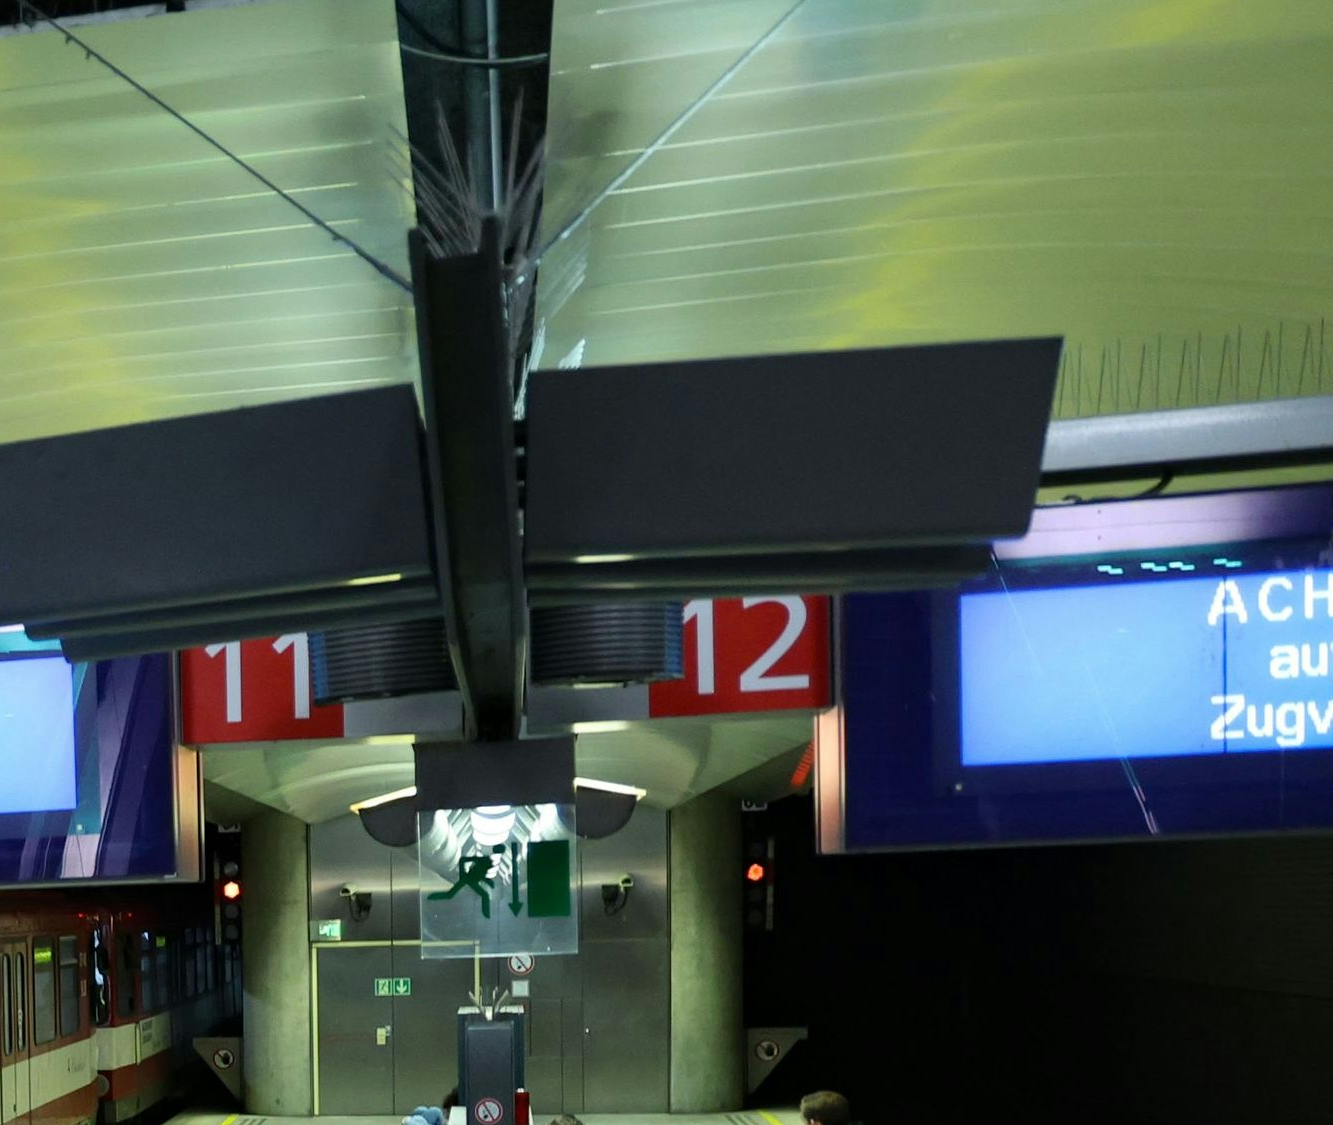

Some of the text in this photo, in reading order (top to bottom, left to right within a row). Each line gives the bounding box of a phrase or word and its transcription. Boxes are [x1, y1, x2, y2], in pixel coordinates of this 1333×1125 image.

[204, 630, 311, 723] 11
[681, 594, 809, 695] 12
[1269, 642, 1333, 679] au
